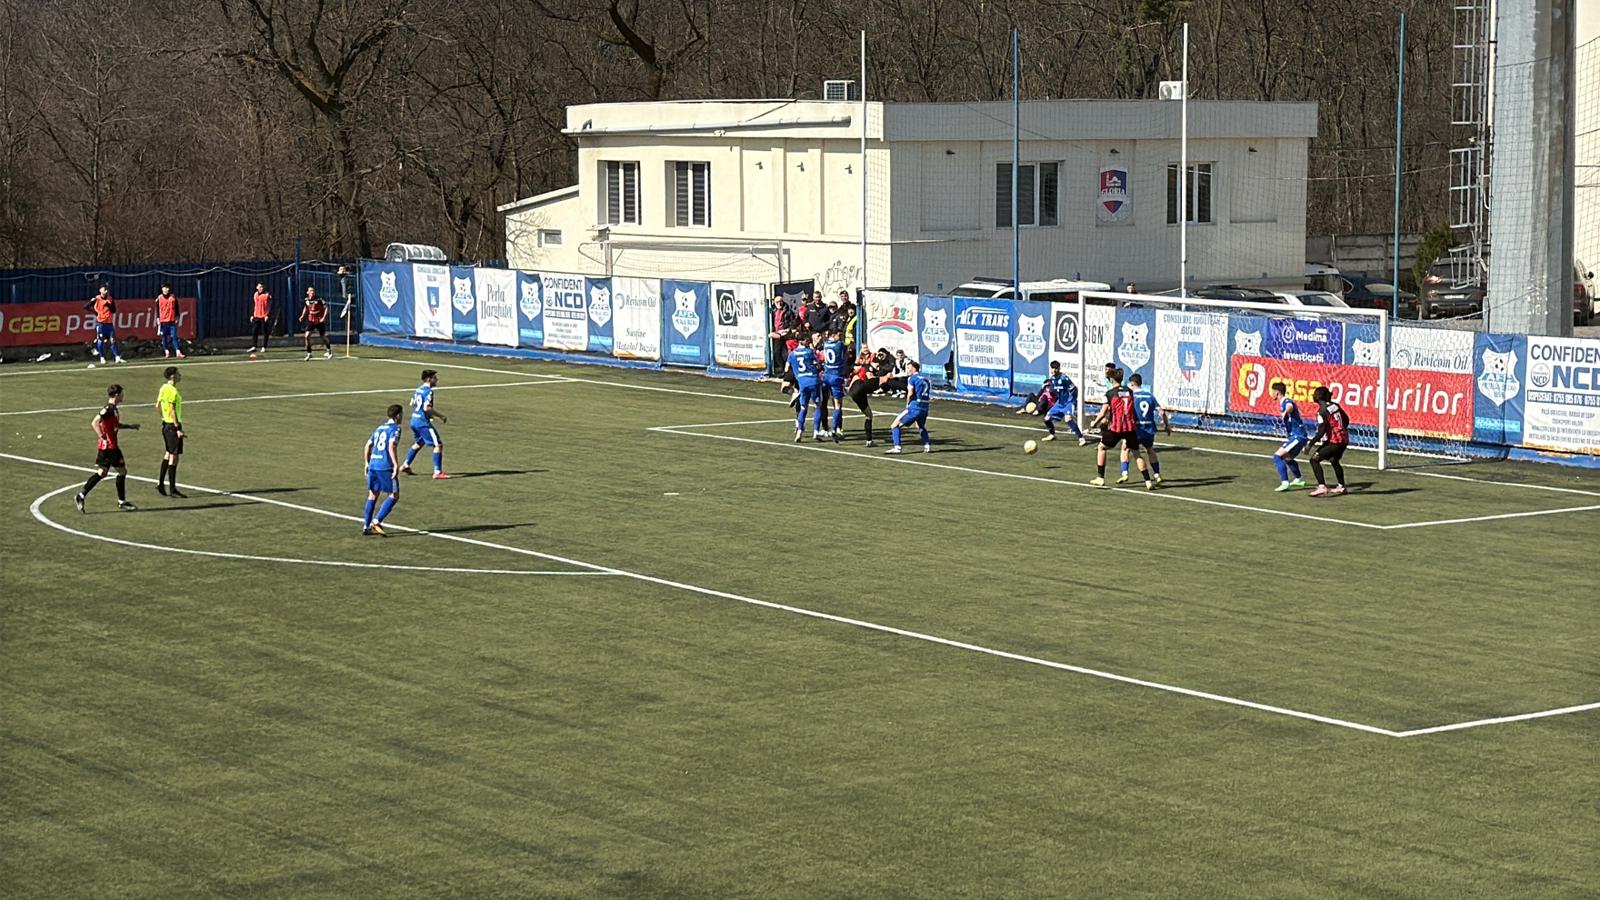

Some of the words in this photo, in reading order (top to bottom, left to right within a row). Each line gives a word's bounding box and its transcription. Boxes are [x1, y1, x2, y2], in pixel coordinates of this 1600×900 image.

[544, 277, 582, 291] CONFIDENT
[487, 284, 505, 303] Perla
[554, 292, 583, 308] NCD
[736, 300, 754, 318] SIGN
[8, 315, 60, 333] casa
[66, 308, 188, 336] paurilr
[982, 314, 1010, 327] TRANS
[1062, 322, 1074, 342] 24
[1084, 324, 1104, 344] SIGN
[1296, 331, 1328, 342] Medima
[798, 358, 806, 372] 3
[1414, 352, 1450, 368] Revicom
[1454, 354, 1468, 370] Oil
[1268, 376, 1323, 403] casa
[1140, 401, 1150, 418] 9
